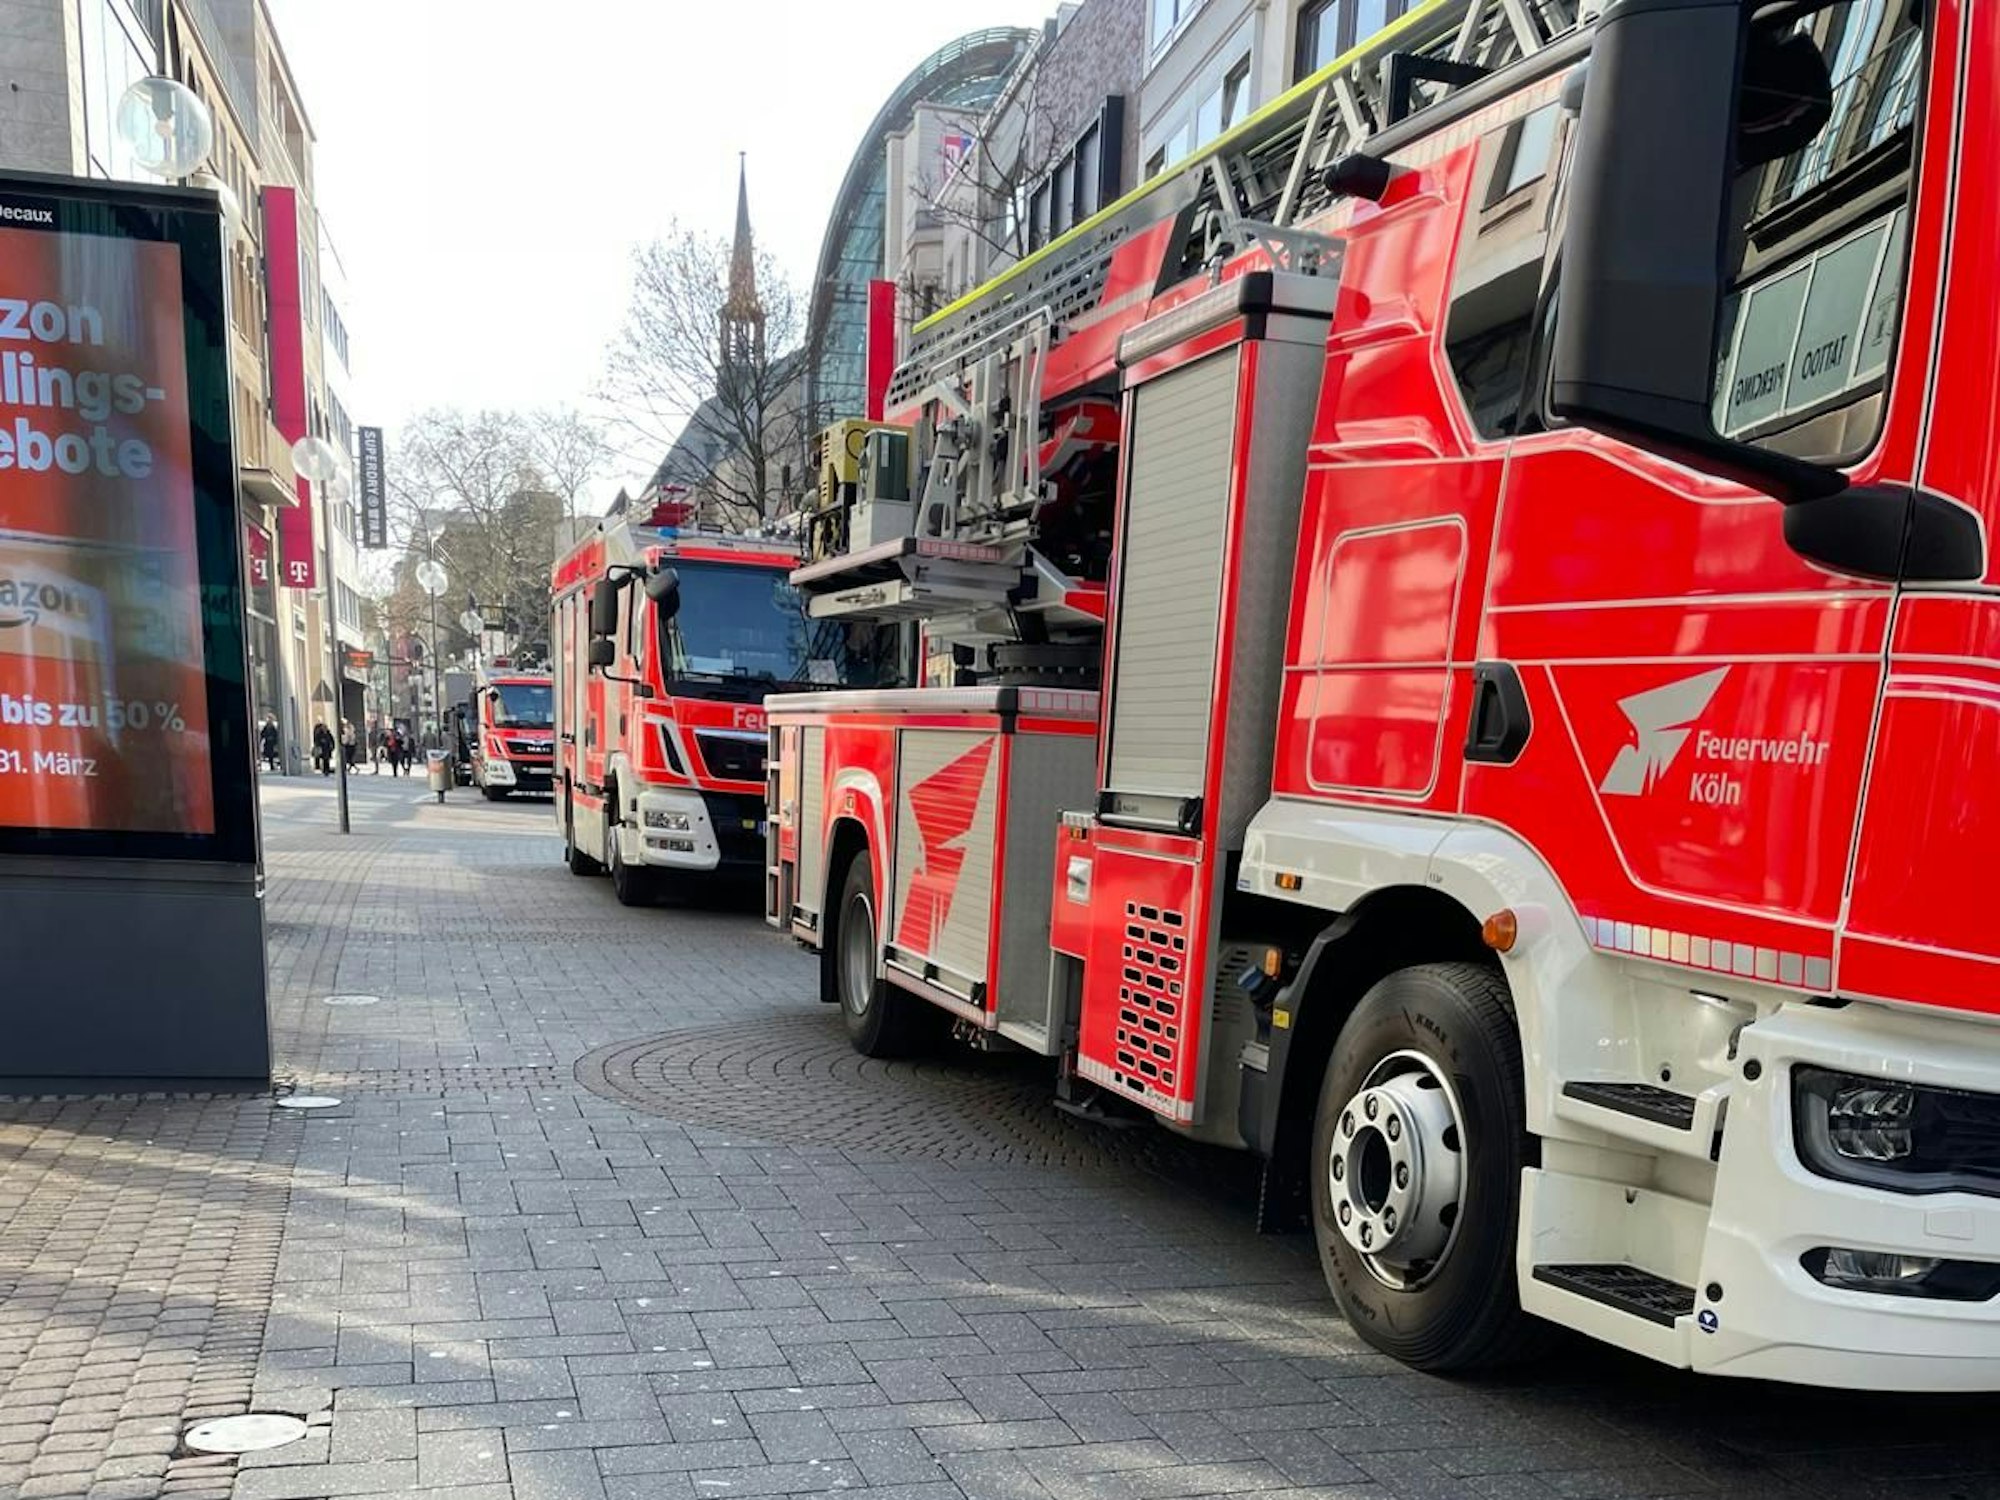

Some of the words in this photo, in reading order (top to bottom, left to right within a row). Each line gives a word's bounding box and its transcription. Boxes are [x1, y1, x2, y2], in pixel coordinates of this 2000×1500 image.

[0, 204, 54, 223] ecaux
[0, 298, 104, 345] zon
[290, 561, 308, 583] T
[1, 693, 52, 726] bis
[58, 703, 99, 727] zu
[105, 700, 149, 729] 50
[154, 702, 186, 732] %
[34, 752, 98, 776] März
[1696, 730, 1829, 765] Feuerwehr
[1688, 772, 1741, 805] Köln
